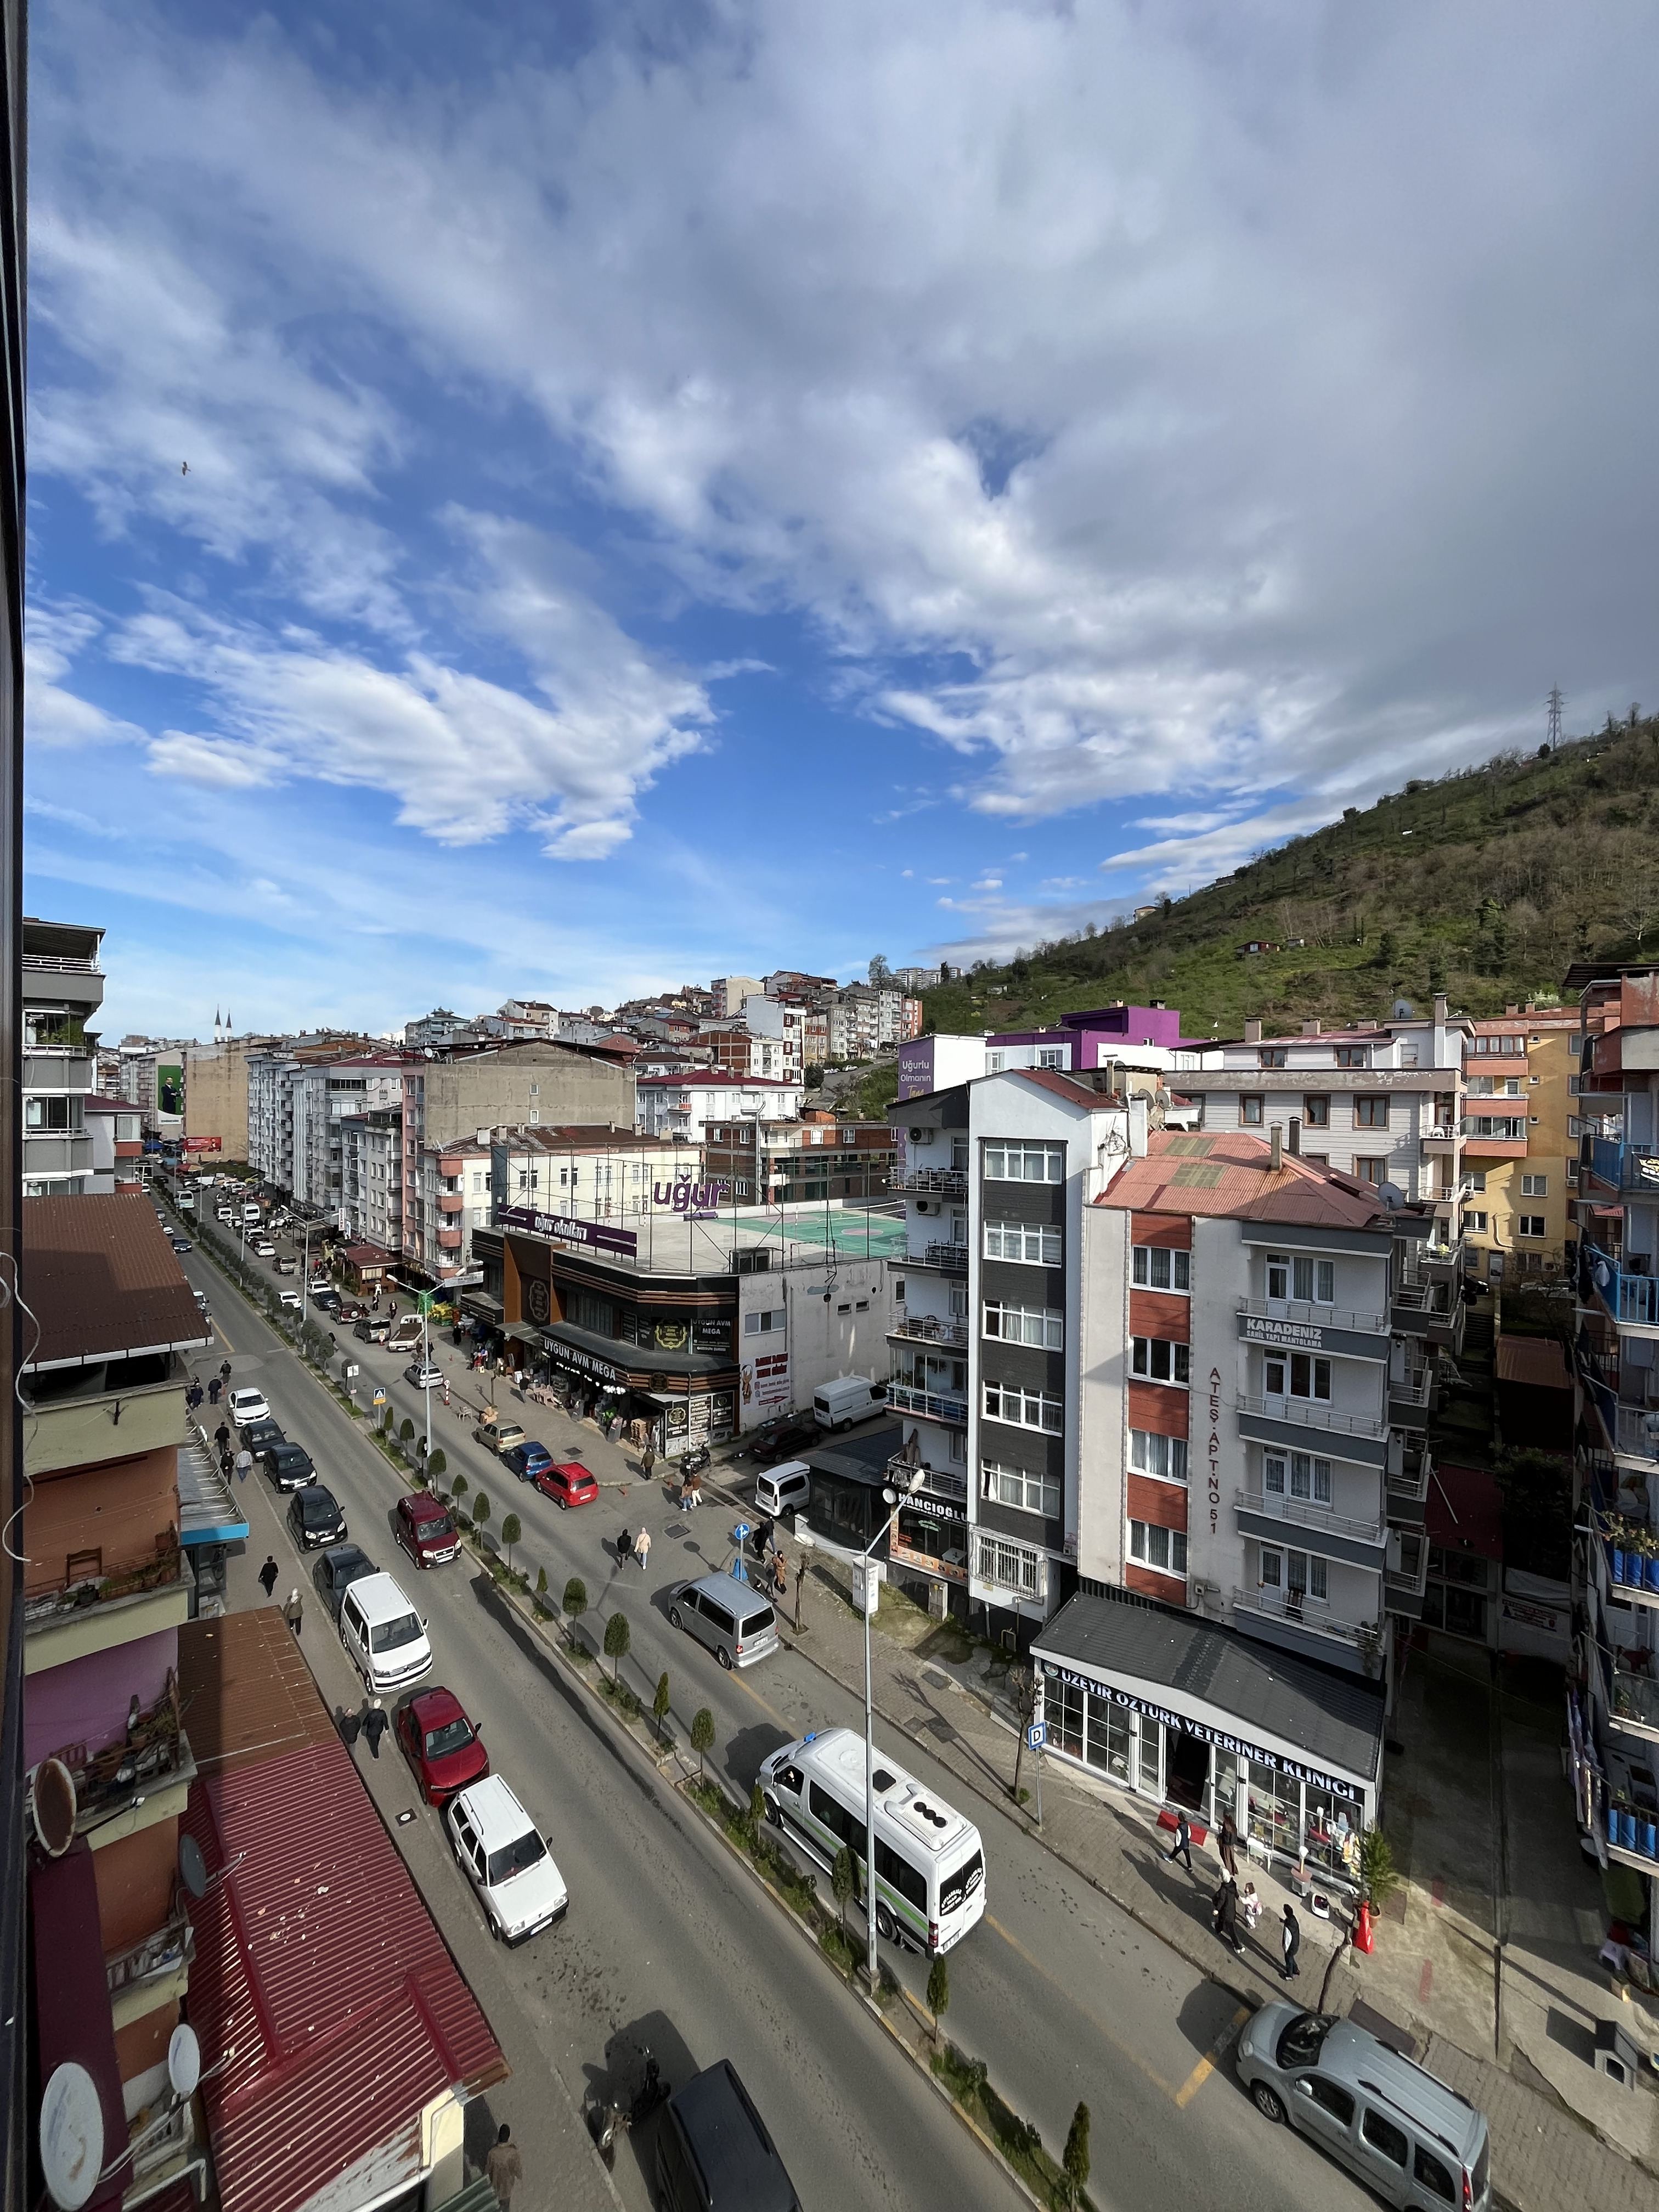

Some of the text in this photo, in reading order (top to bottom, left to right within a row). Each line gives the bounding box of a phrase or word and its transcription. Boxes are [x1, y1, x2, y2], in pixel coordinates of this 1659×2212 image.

[902, 1060, 929, 1072] Uğurlu
[900, 1074, 931, 1082] Olmanın
[654, 1175, 730, 1212] uğur
[534, 1214, 588, 1240] uğur okulları
[1246, 1318, 1322, 1341] KARADENİZ
[1281, 1335, 1322, 1348] MANTOLAMA
[544, 1338, 616, 1381] UYGUN AVM MEGA
[1034, 1730, 1041, 1742] D
[1184, 1718, 1277, 1768] VETERİNER
[1283, 1759, 1355, 1800] KLİNİĞİ
